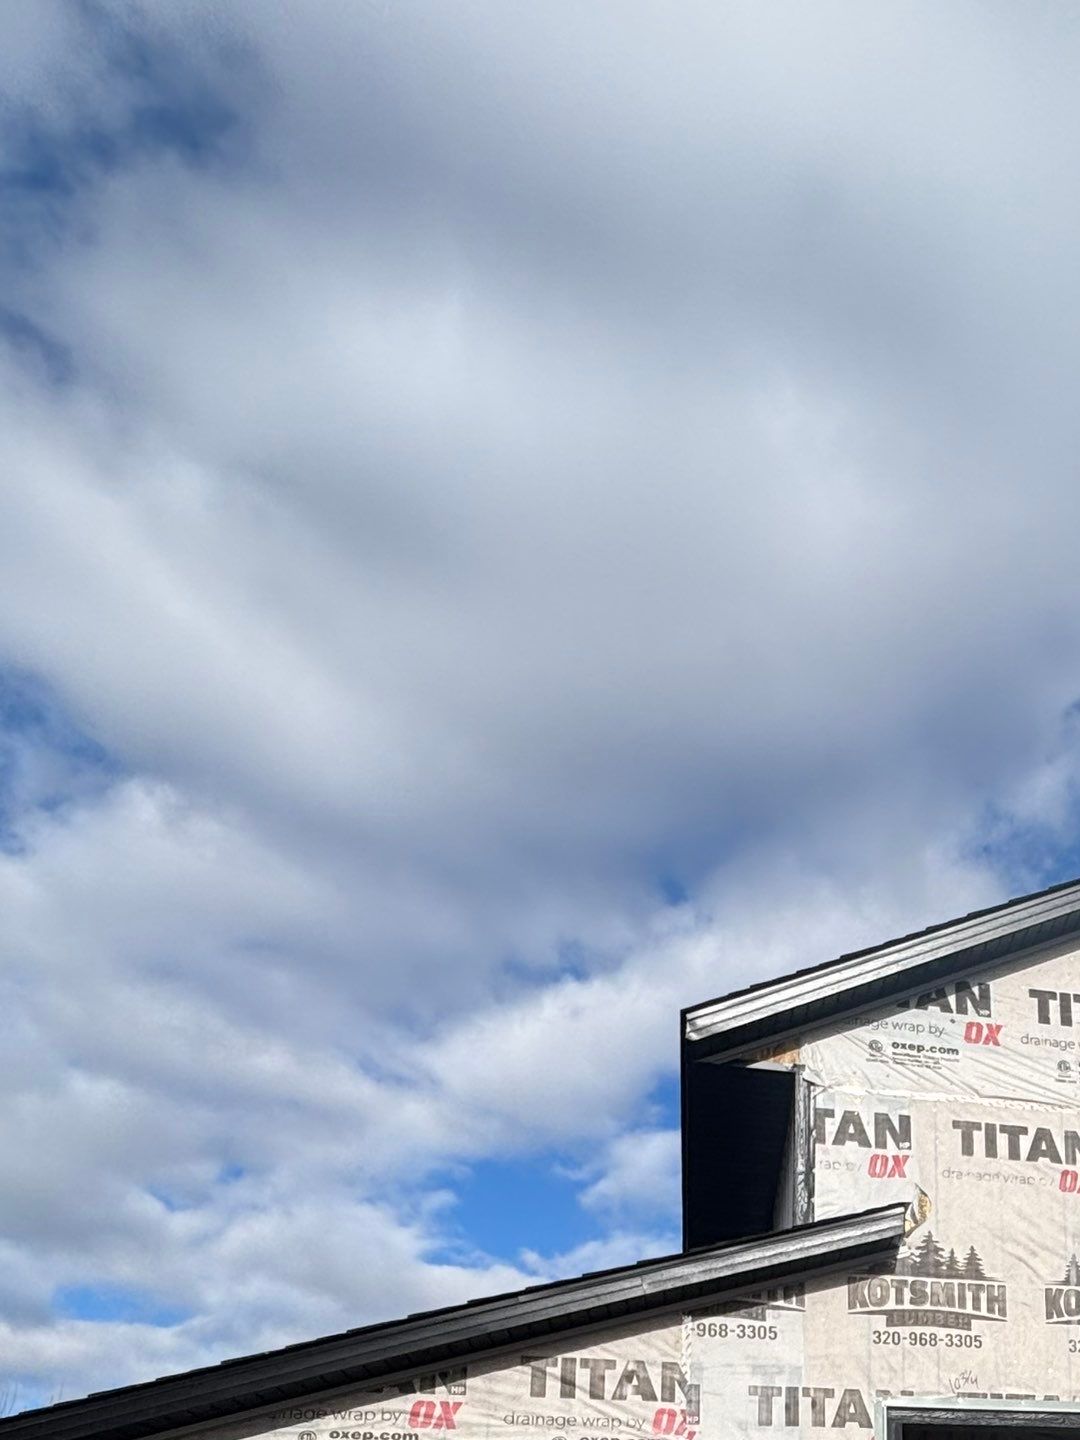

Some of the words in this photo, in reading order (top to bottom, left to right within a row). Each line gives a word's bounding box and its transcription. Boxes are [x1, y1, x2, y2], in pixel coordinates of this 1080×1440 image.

[892, 1022, 925, 1036] wrap
[929, 1022, 945, 1038] by
[964, 1021, 1003, 1047] OX
[1020, 1034, 1076, 1051] drainage
[892, 1041, 959, 1056] oxep.com
[868, 1154, 910, 1178] OX
[848, 1277, 1007, 1318] KOTSMITH
[873, 1331, 983, 1349] 320-968-3305
[451, 1386, 465, 1394] HP
[521, 1355, 700, 1420] TITAN
[333, 1409, 376, 1423] wrap
[381, 1408, 403, 1425] by
[408, 1400, 463, 1430] OX
[748, 1385, 874, 1428] TITA
[503, 1411, 577, 1430] drainage
[580, 1415, 622, 1430] wrap
[626, 1413, 646, 1430] by
[687, 1415, 699, 1424] HP
